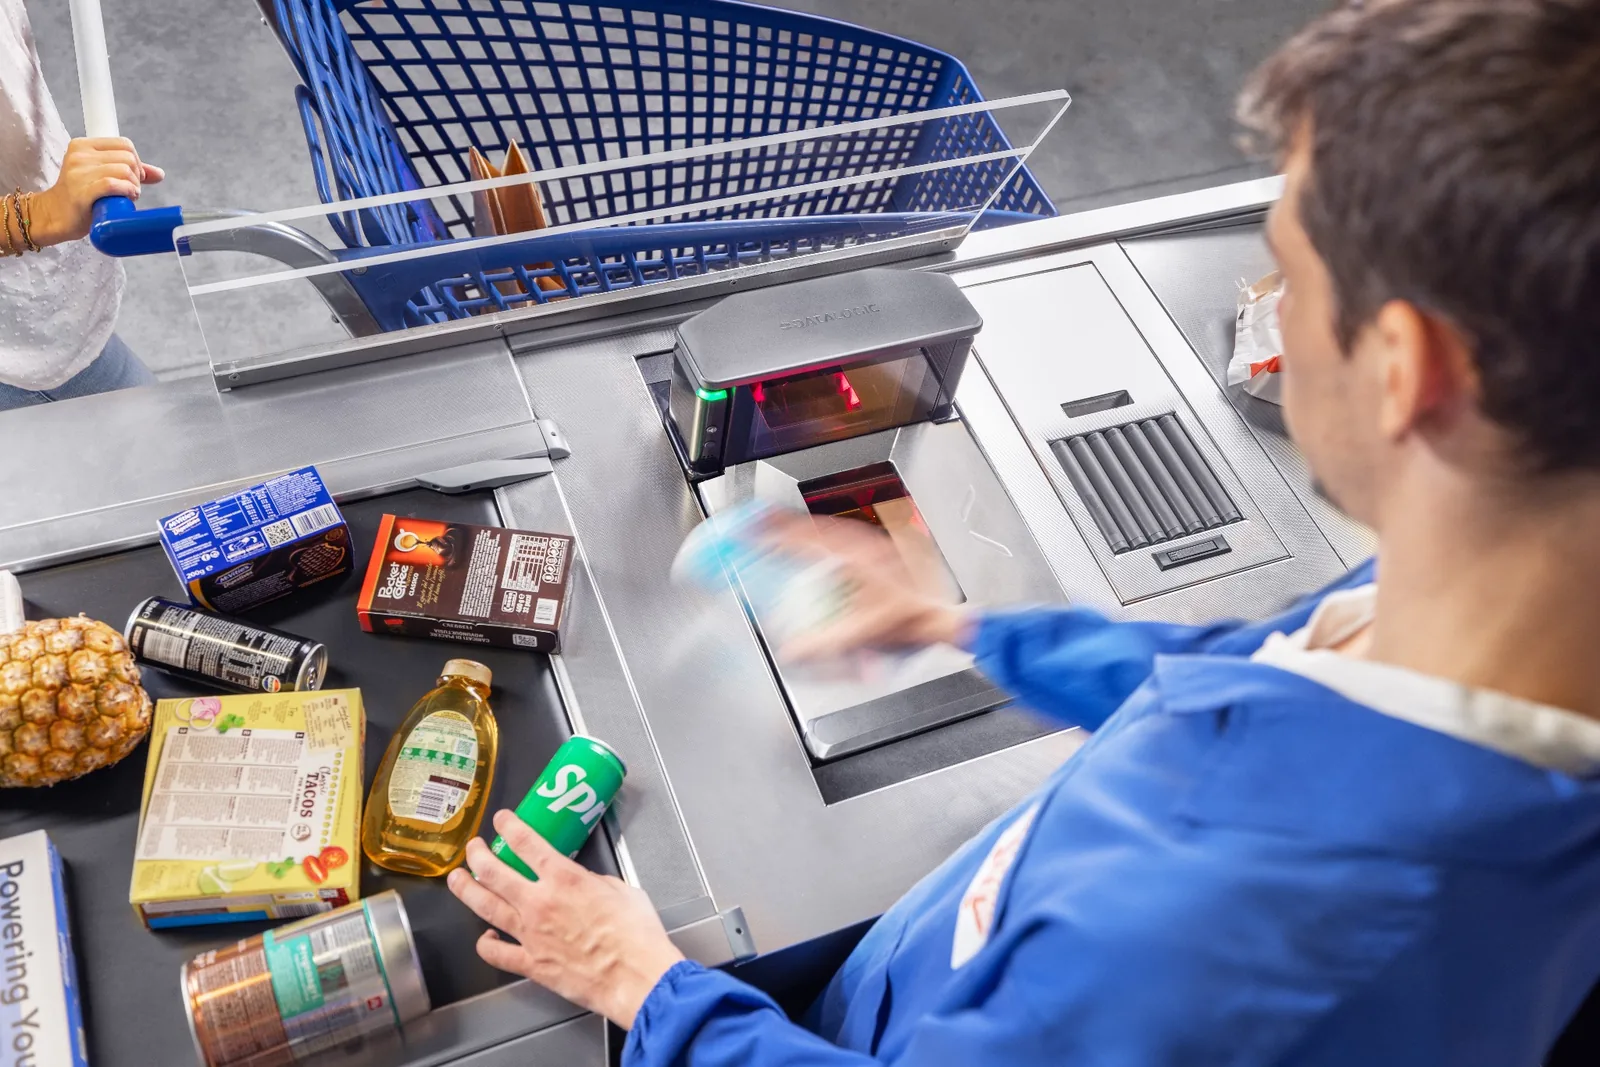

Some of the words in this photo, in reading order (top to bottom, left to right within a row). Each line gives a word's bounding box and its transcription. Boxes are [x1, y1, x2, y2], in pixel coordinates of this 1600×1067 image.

[791, 303, 880, 329] DATALOGIC
[186, 569, 206, 580] 200g
[377, 561, 400, 599] Pocket
[392, 564, 409, 600] Coffee
[408, 572, 419, 597] CLASSICO
[300, 772, 319, 818] TACOS
[0, 859, 33, 1006] Powering
